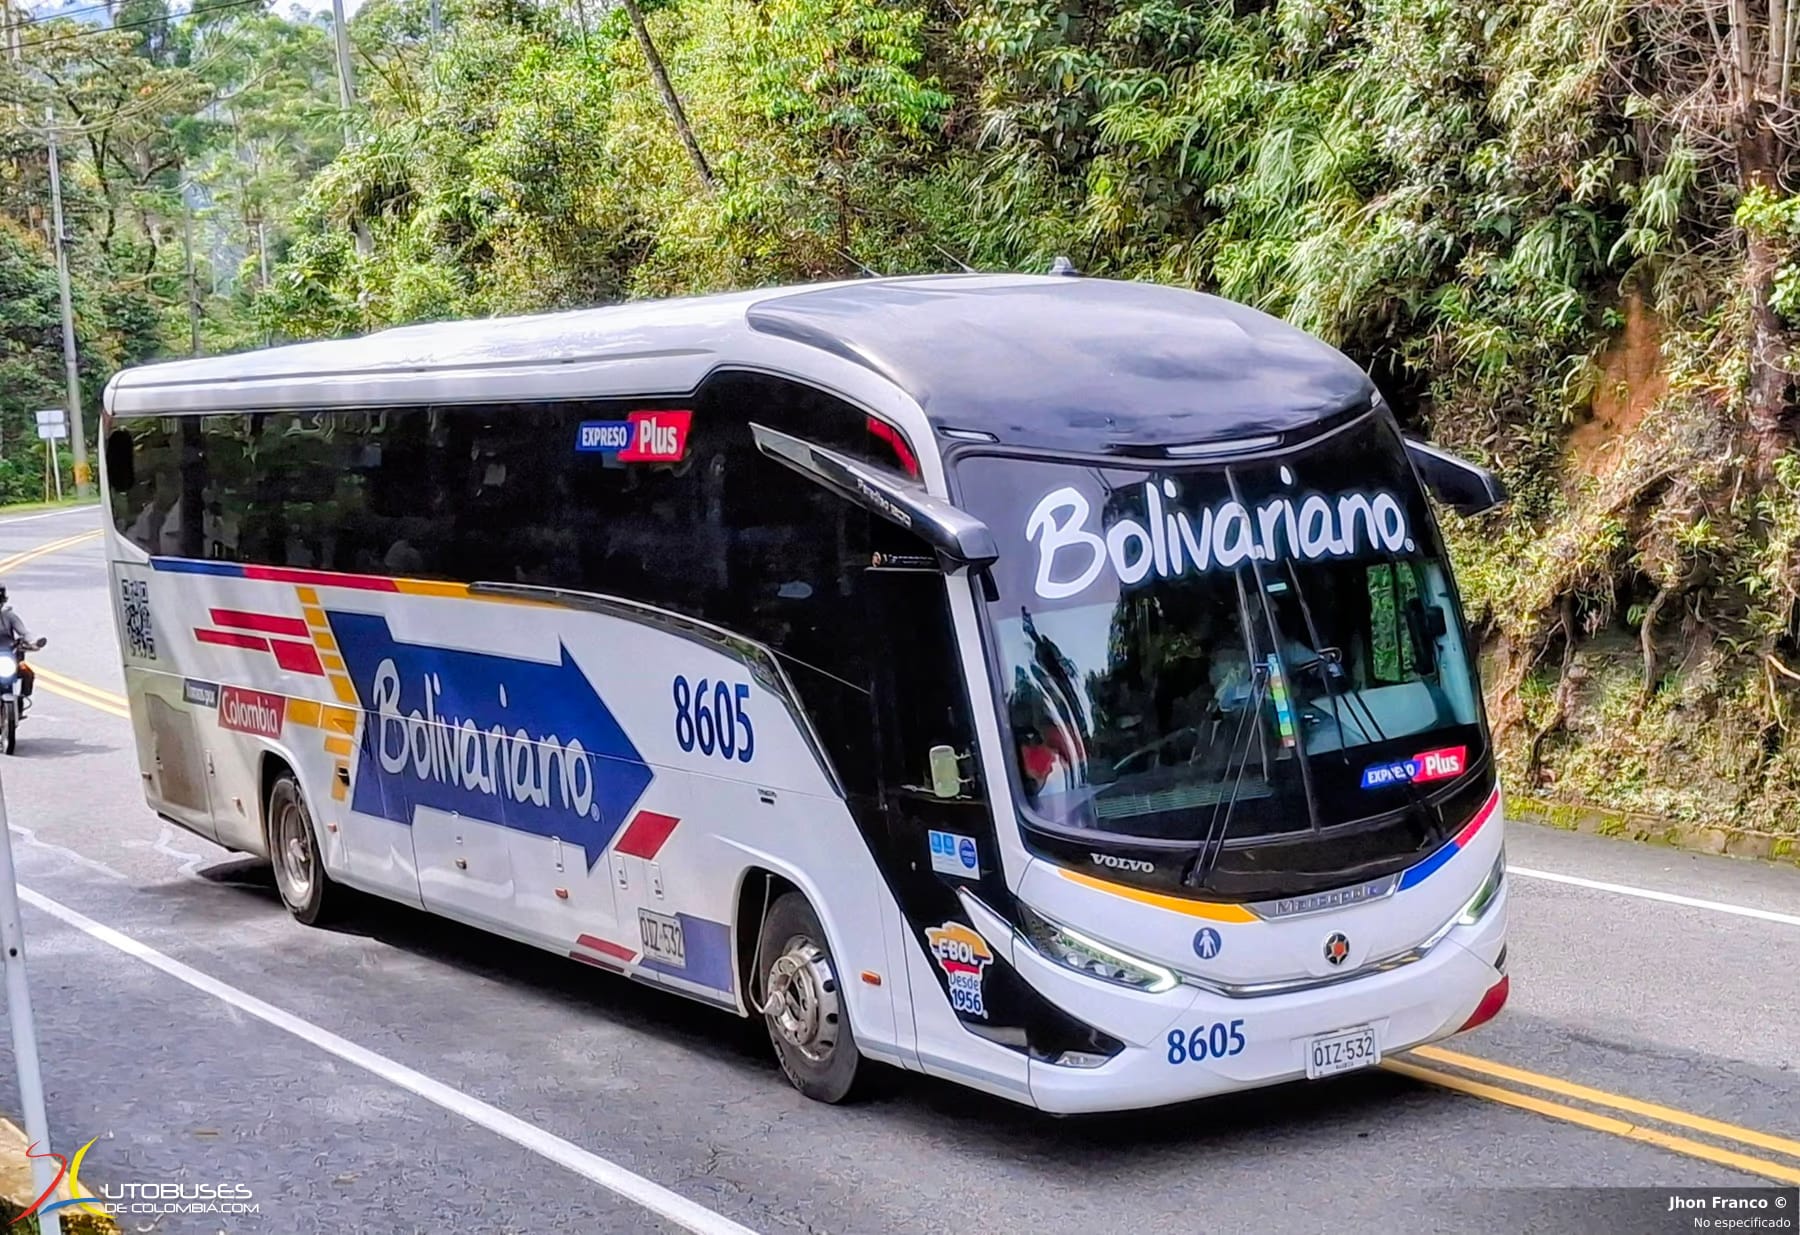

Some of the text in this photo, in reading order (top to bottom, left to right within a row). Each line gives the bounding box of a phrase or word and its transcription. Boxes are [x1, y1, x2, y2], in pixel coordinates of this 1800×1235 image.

[582, 416, 678, 455] EXPRESO Plus
[1026, 465, 1406, 599] Bolivariano
[222, 691, 280, 735] Colombia
[673, 674, 754, 764] 8605
[373, 658, 593, 818] Bolivariano
[1424, 752, 1460, 777] Plus
[1089, 852, 1155, 874] VOLVO
[949, 972, 979, 992] Desde
[951, 987, 982, 1013] 1956
[1167, 1018, 1246, 1065] 8605
